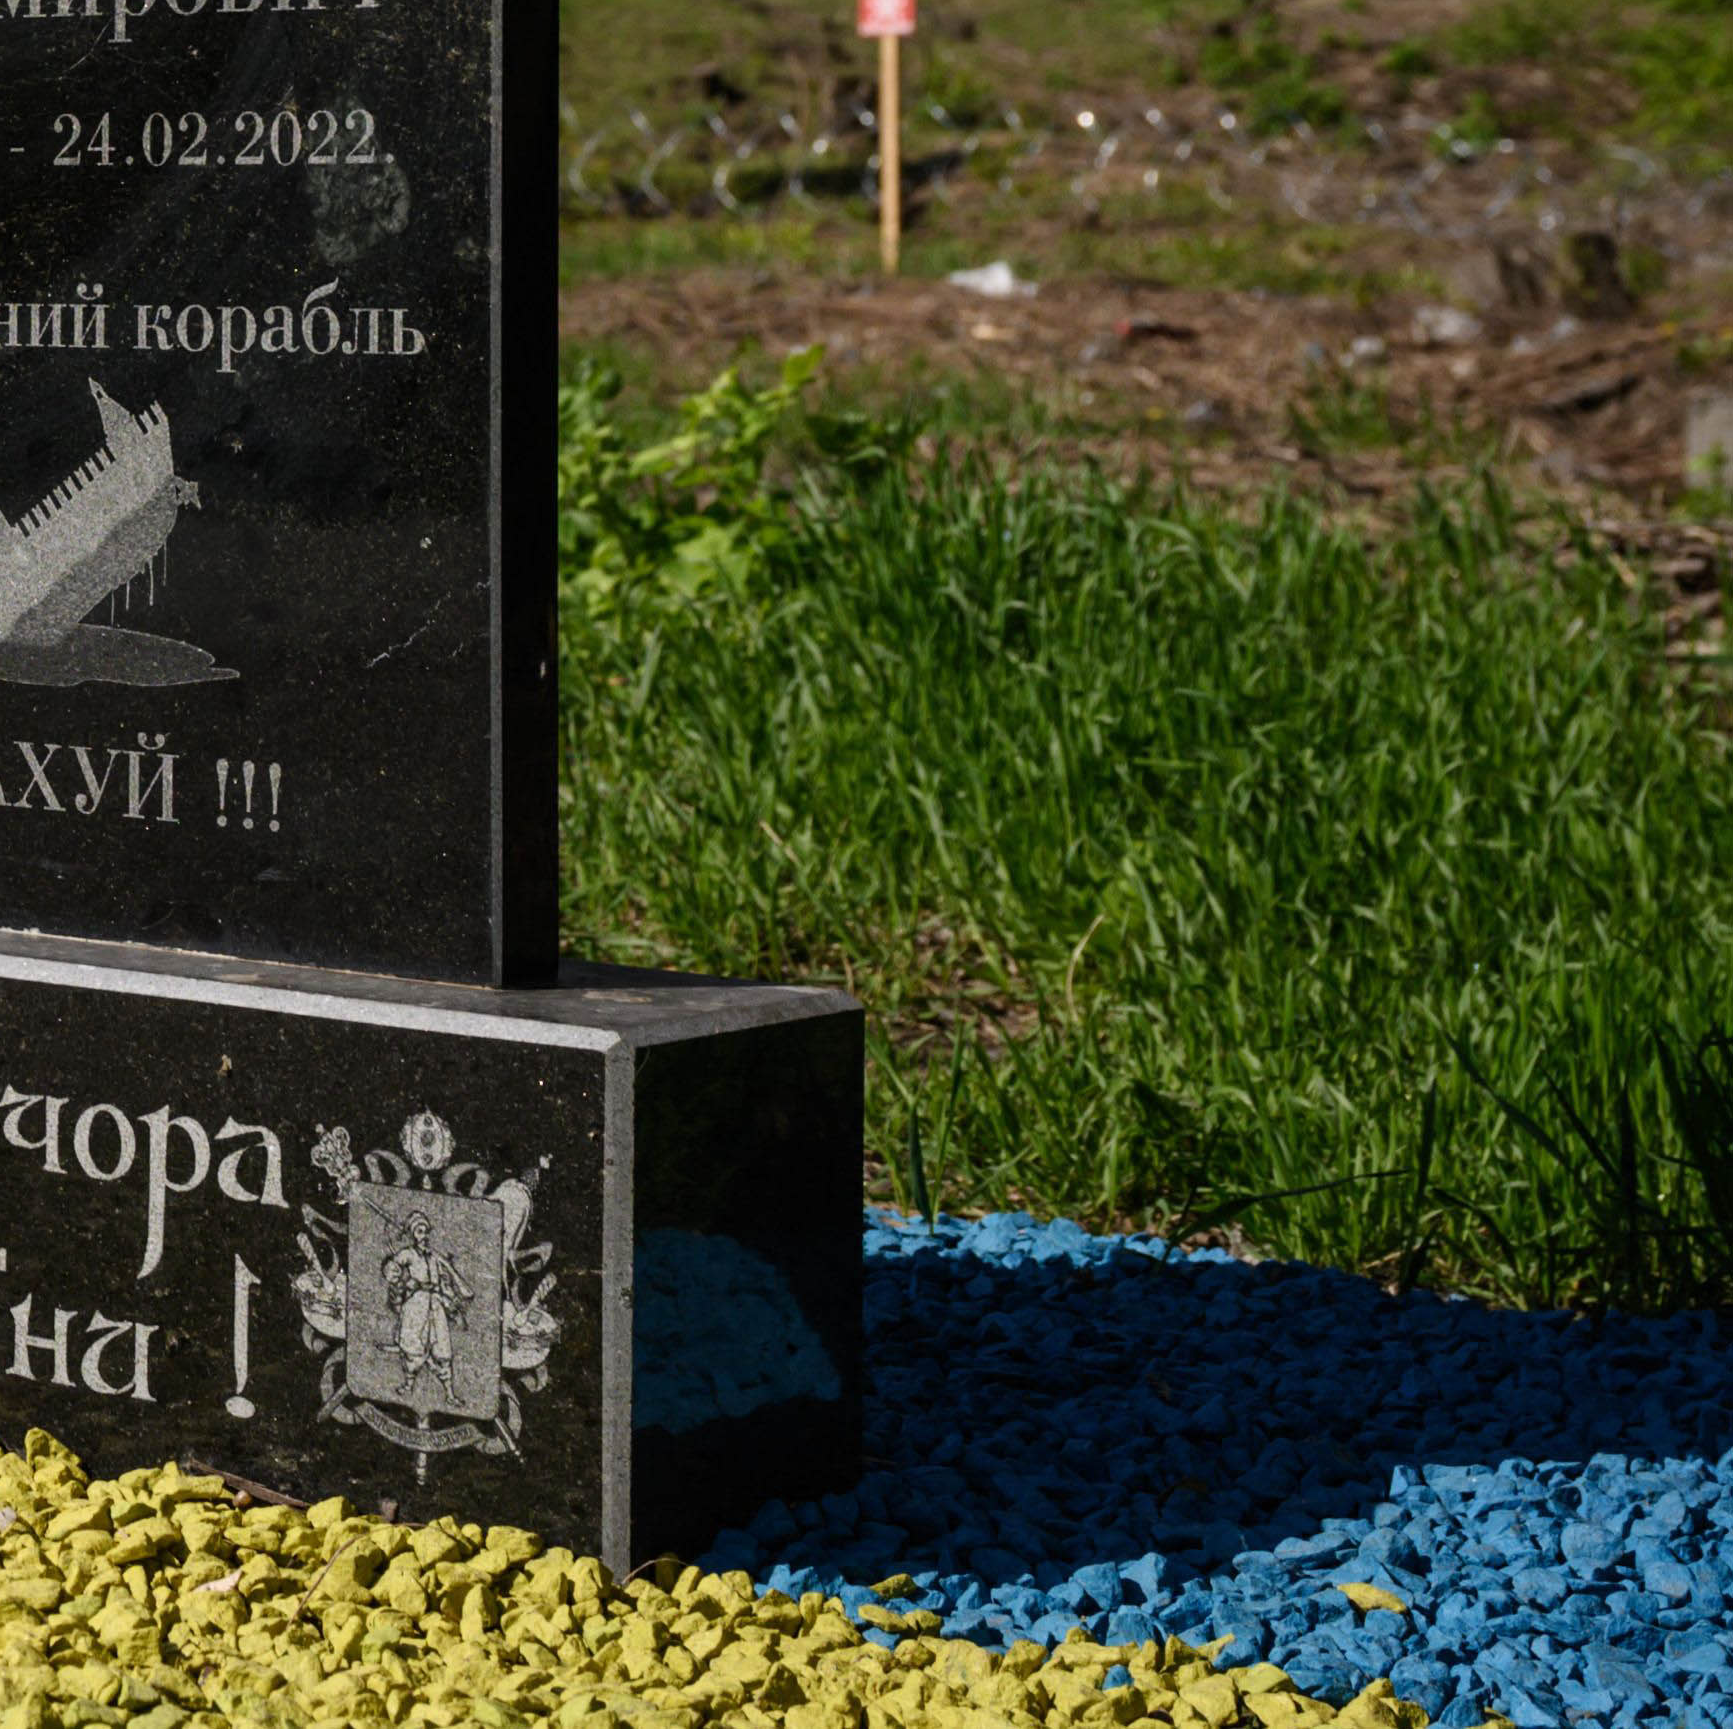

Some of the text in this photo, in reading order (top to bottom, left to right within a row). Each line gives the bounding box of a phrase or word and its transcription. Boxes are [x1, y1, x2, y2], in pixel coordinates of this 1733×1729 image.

[52, 109, 395, 168] 24.02.2022.
[133, 275, 426, 372] корабль
[216, 757, 282, 833] !!!
[225, 1253, 261, 1421] !
